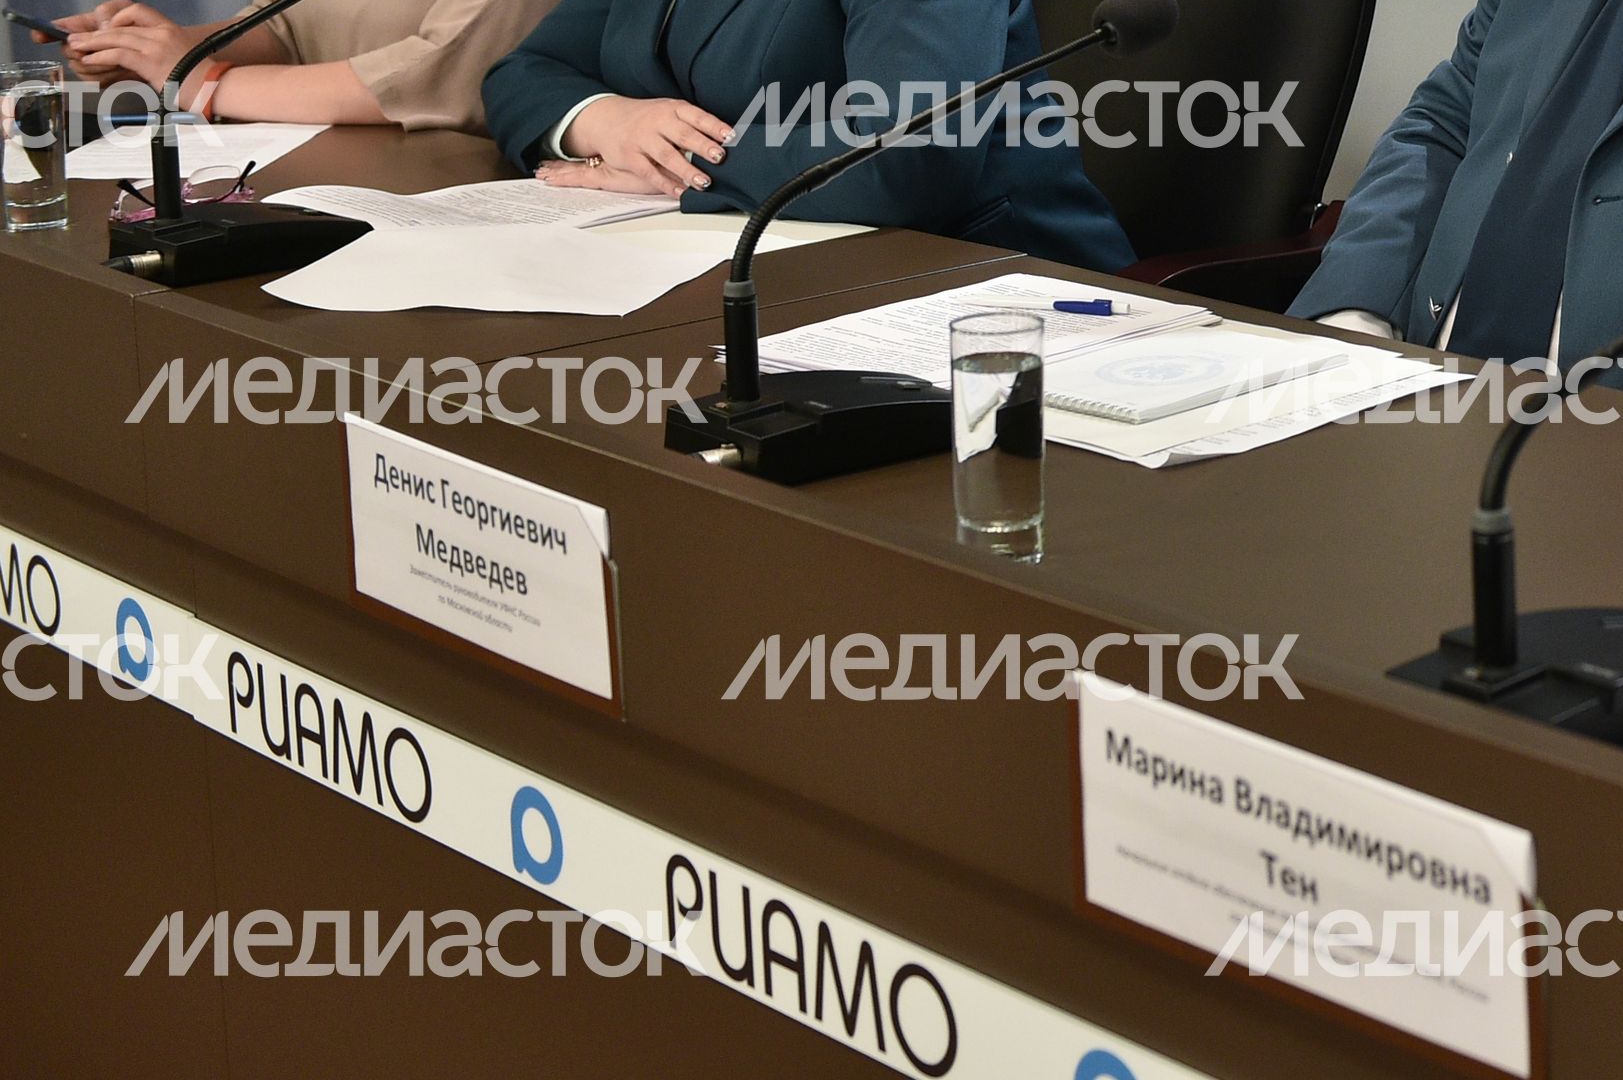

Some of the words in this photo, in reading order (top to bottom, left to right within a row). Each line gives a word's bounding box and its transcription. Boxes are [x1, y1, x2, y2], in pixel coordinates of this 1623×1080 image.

[374, 453, 436, 504] Денис
[440, 478, 568, 555] Георгиевич
[415, 524, 528, 595] Медведев
[228, 651, 432, 824] РИАМО
[1106, 729, 1225, 805] Марина
[1234, 775, 1492, 906] Владимировна
[1259, 850, 1320, 904] Тен
[666, 854, 957, 1078] РИАМО
